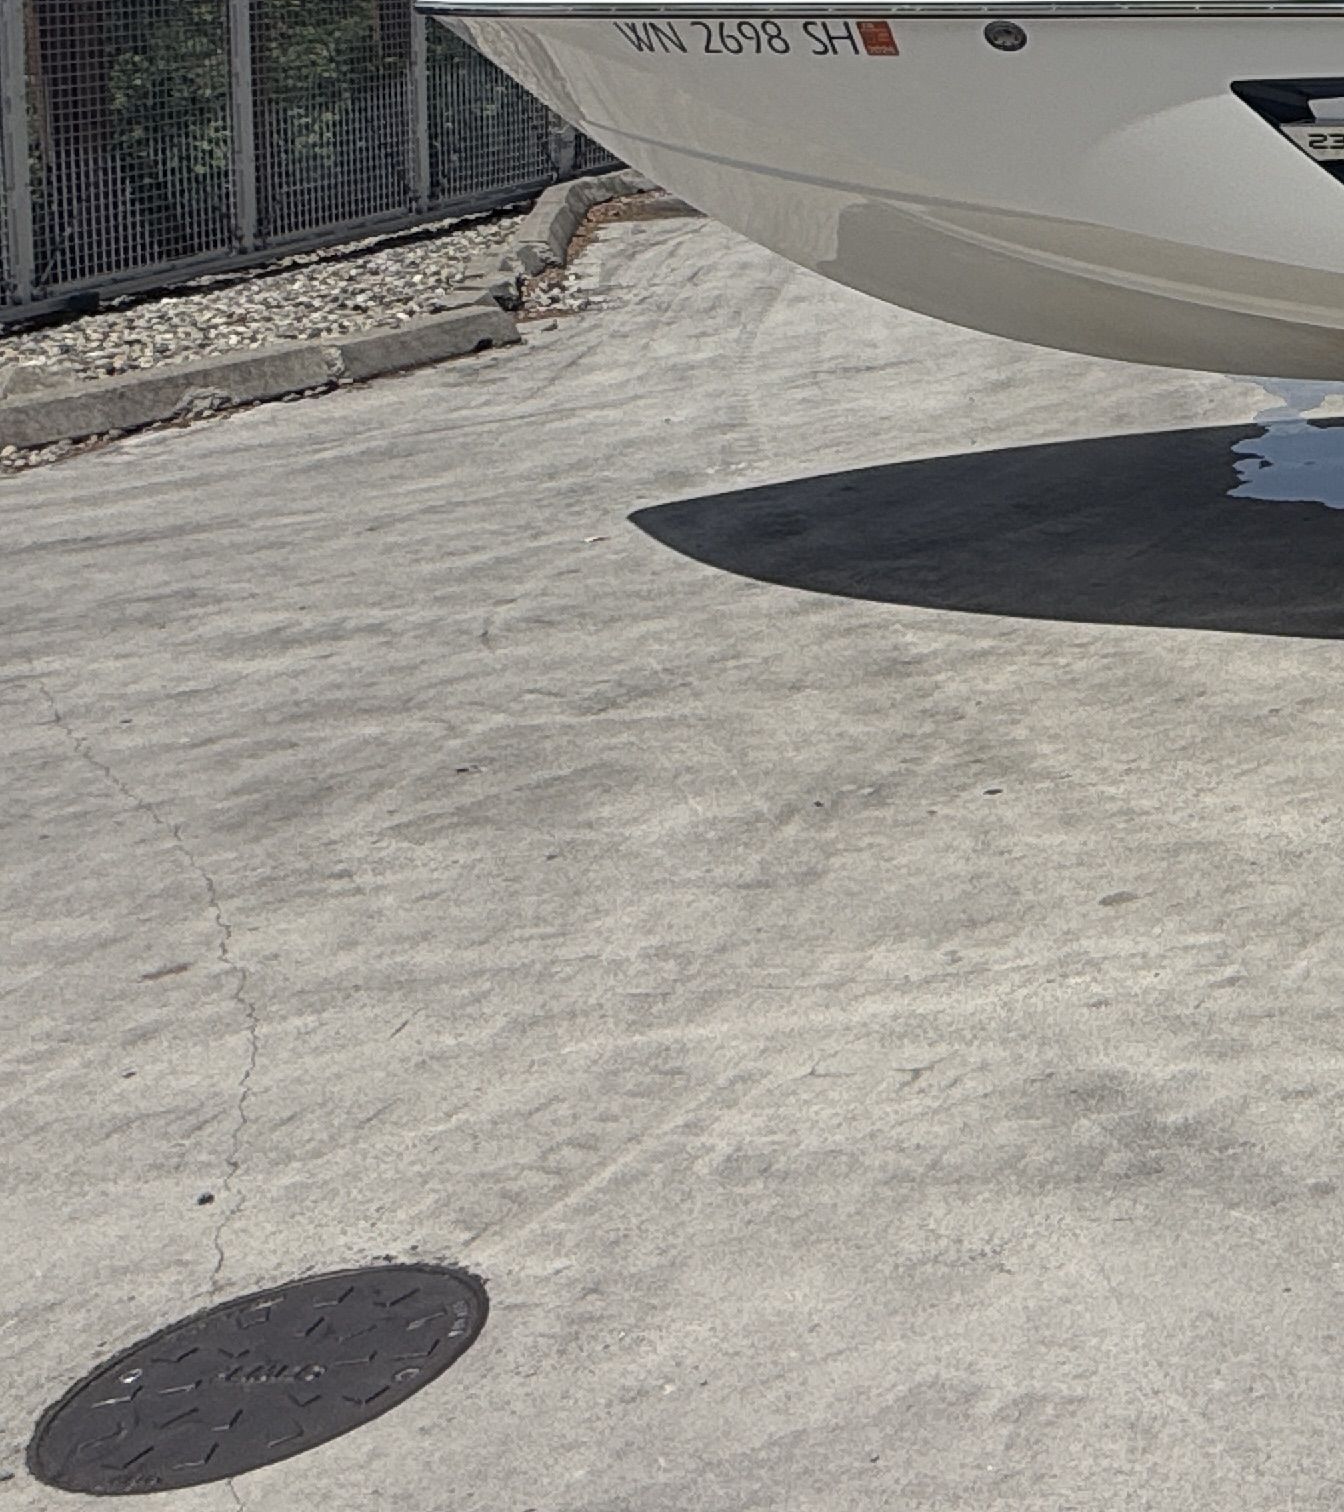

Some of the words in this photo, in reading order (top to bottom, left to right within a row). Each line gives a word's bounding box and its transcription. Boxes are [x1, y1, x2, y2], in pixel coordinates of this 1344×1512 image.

[612, 21, 688, 54] WN
[690, 19, 790, 55] 2698
[802, 21, 860, 56] SH
